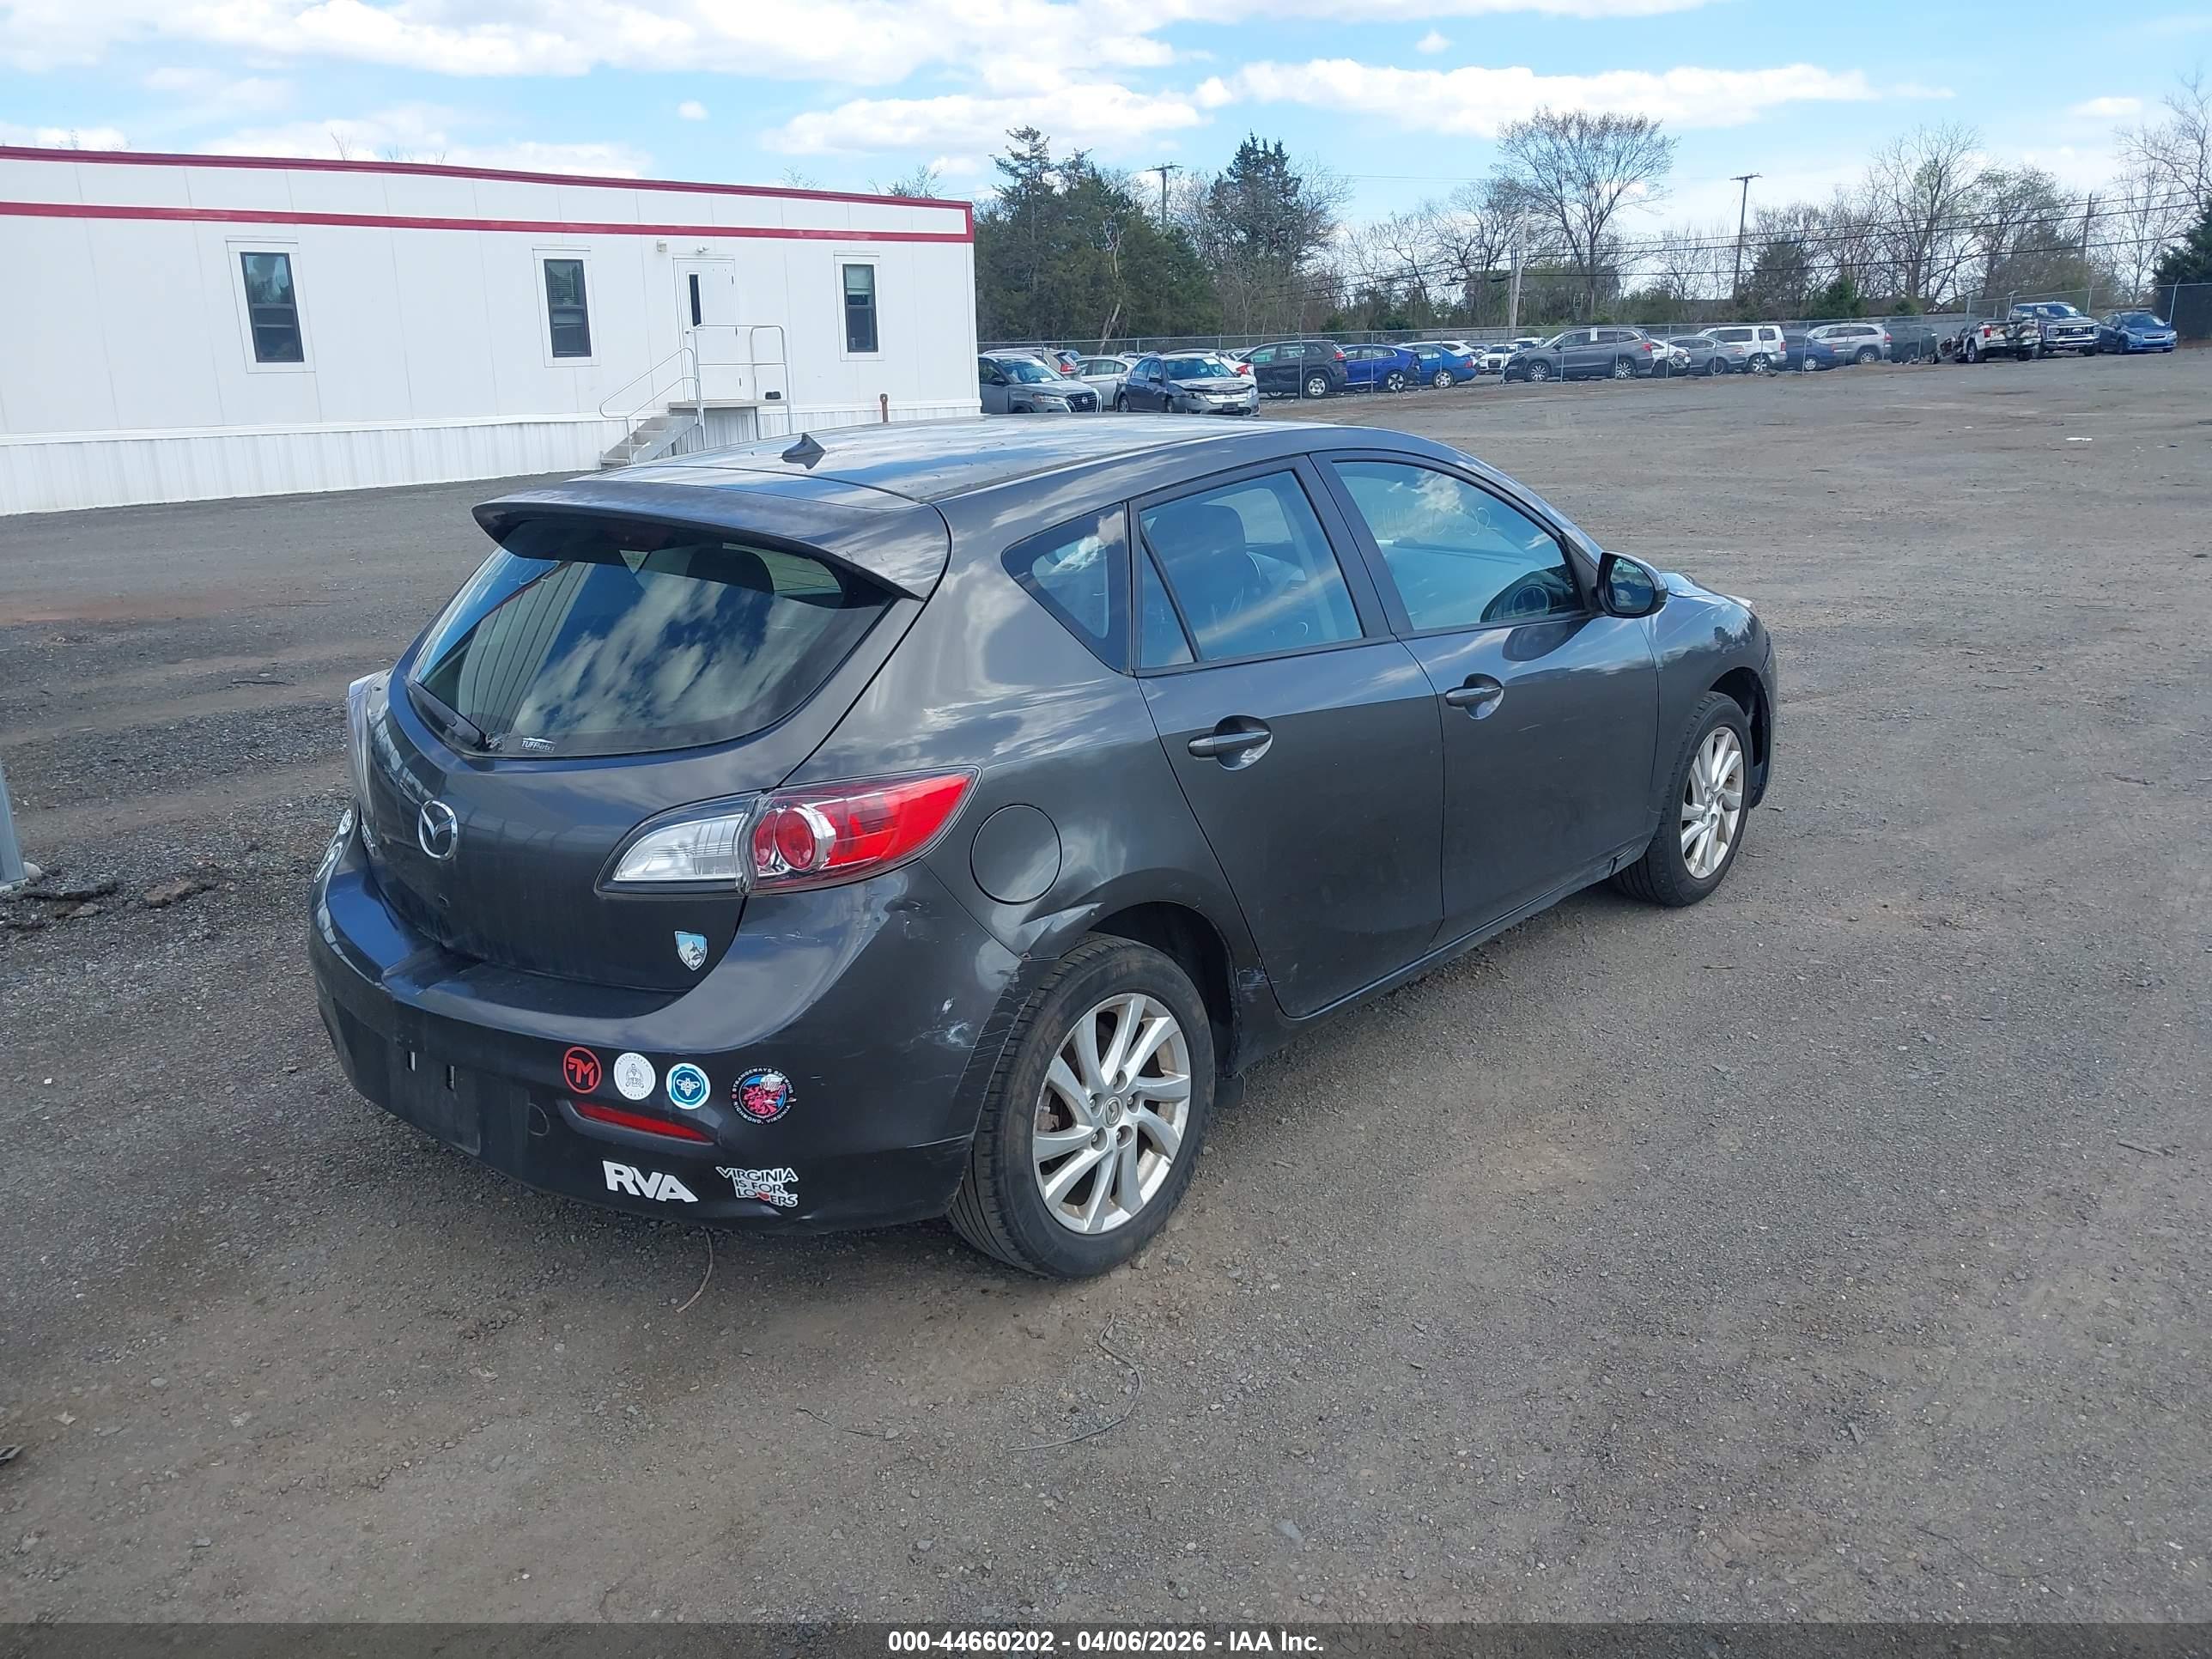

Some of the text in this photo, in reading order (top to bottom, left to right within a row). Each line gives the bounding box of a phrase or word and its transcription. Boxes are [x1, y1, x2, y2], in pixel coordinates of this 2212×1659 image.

[766, 1105, 791, 1123] VIRGINIA
[602, 1160, 699, 1203] RVA
[715, 1166, 799, 1182] VIRGINIA
[734, 1178, 787, 1194] IS FOR
